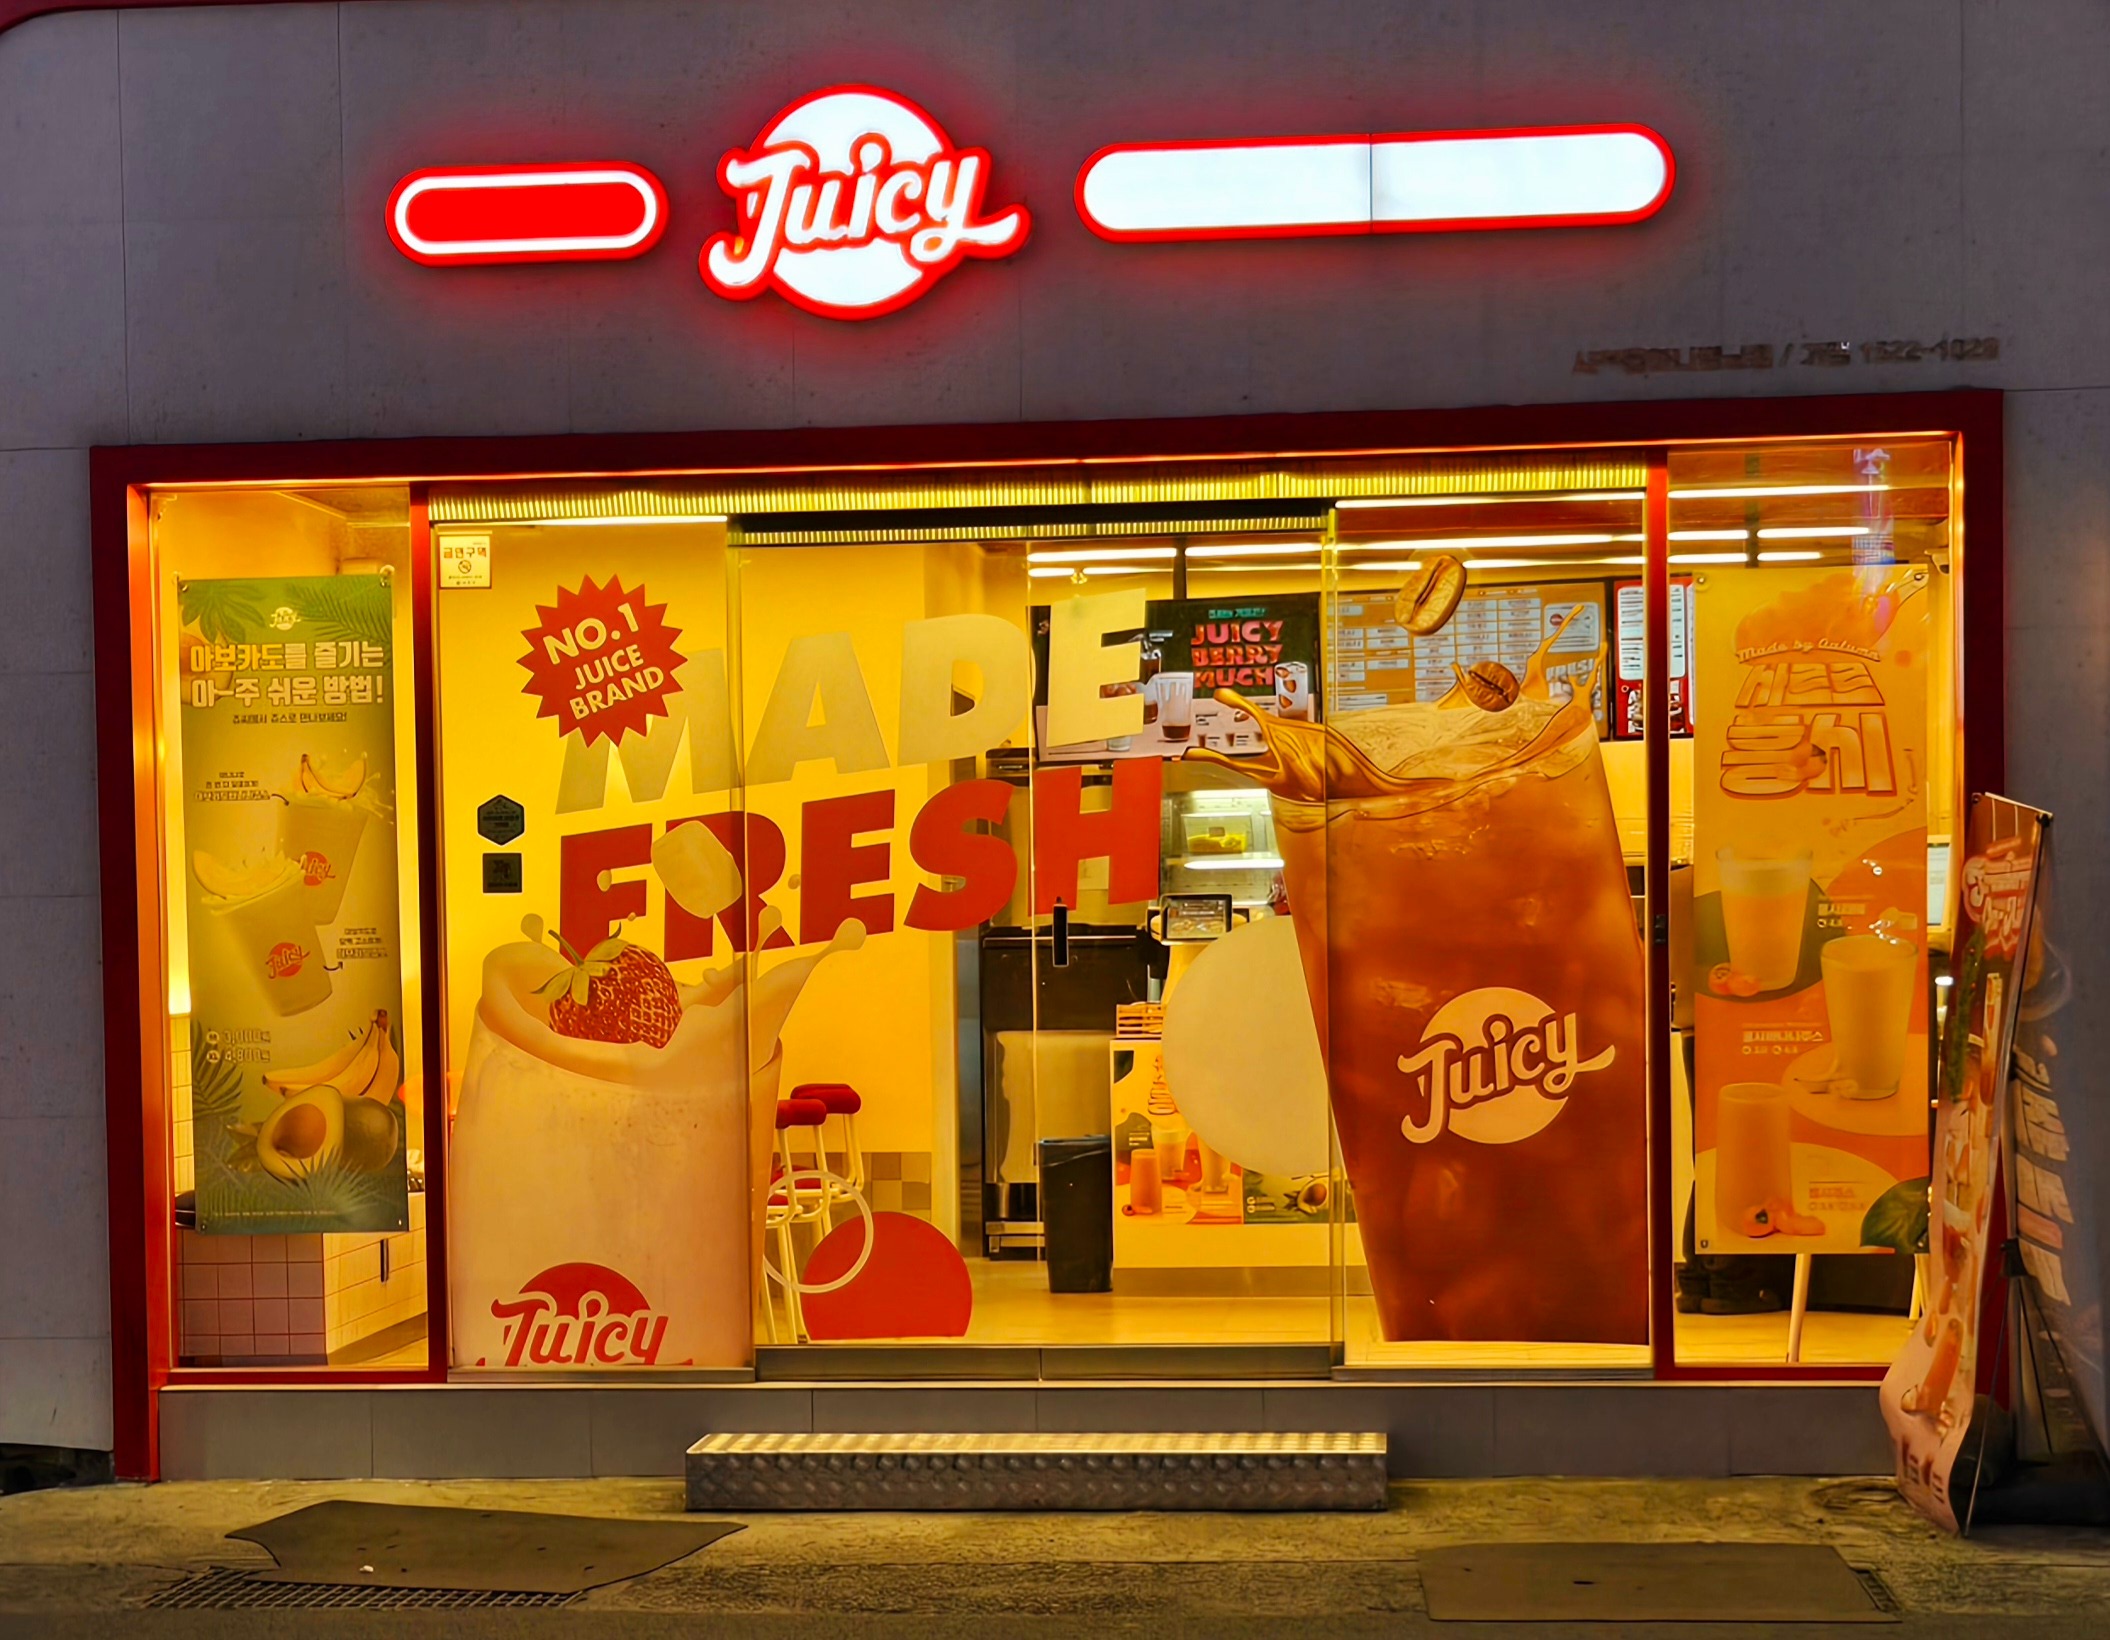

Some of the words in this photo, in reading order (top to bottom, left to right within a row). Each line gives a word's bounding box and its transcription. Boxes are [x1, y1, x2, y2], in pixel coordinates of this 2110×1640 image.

[707, 142, 1021, 289] Juicy
[190, 642, 307, 673] 아보카도를
[314, 641, 384, 669] 즐기는
[542, 602, 639, 665] NO.1
[1190, 620, 1284, 646] JUICY
[1191, 644, 1284, 667] BERRY
[267, 676, 317, 707] 쉬운
[323, 675, 384, 705] 방법!
[574, 644, 644, 690] JUICE
[1194, 666, 1276, 689] MUCH
[554, 588, 1147, 815] MADE
[569, 666, 664, 720] BRAND
[560, 756, 1163, 963] FRESH
[1397, 1020, 1616, 1144] Juicy
